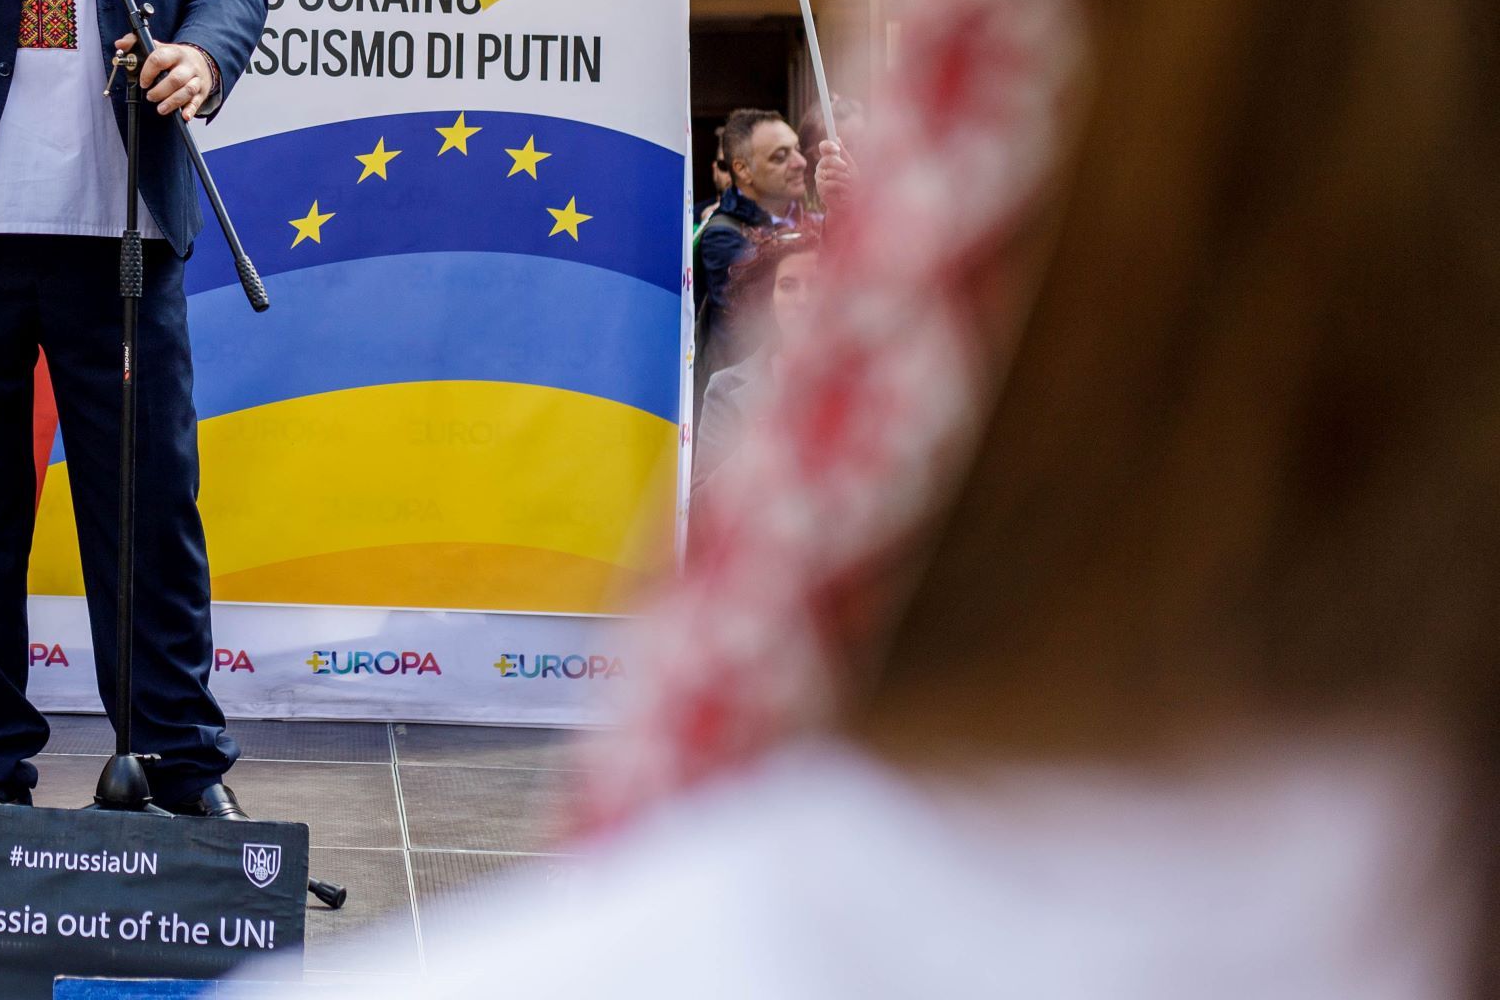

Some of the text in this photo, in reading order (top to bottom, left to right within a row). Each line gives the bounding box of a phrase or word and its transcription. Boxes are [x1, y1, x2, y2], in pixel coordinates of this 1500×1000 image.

[245, 27, 602, 83] SCISMO DI PUTIN
[10, 845, 158, 876] #unrussiaUN
[57, 911, 111, 941] out
[118, 910, 154, 942] of
[159, 913, 211, 946] the
[220, 917, 276, 950] UN!
